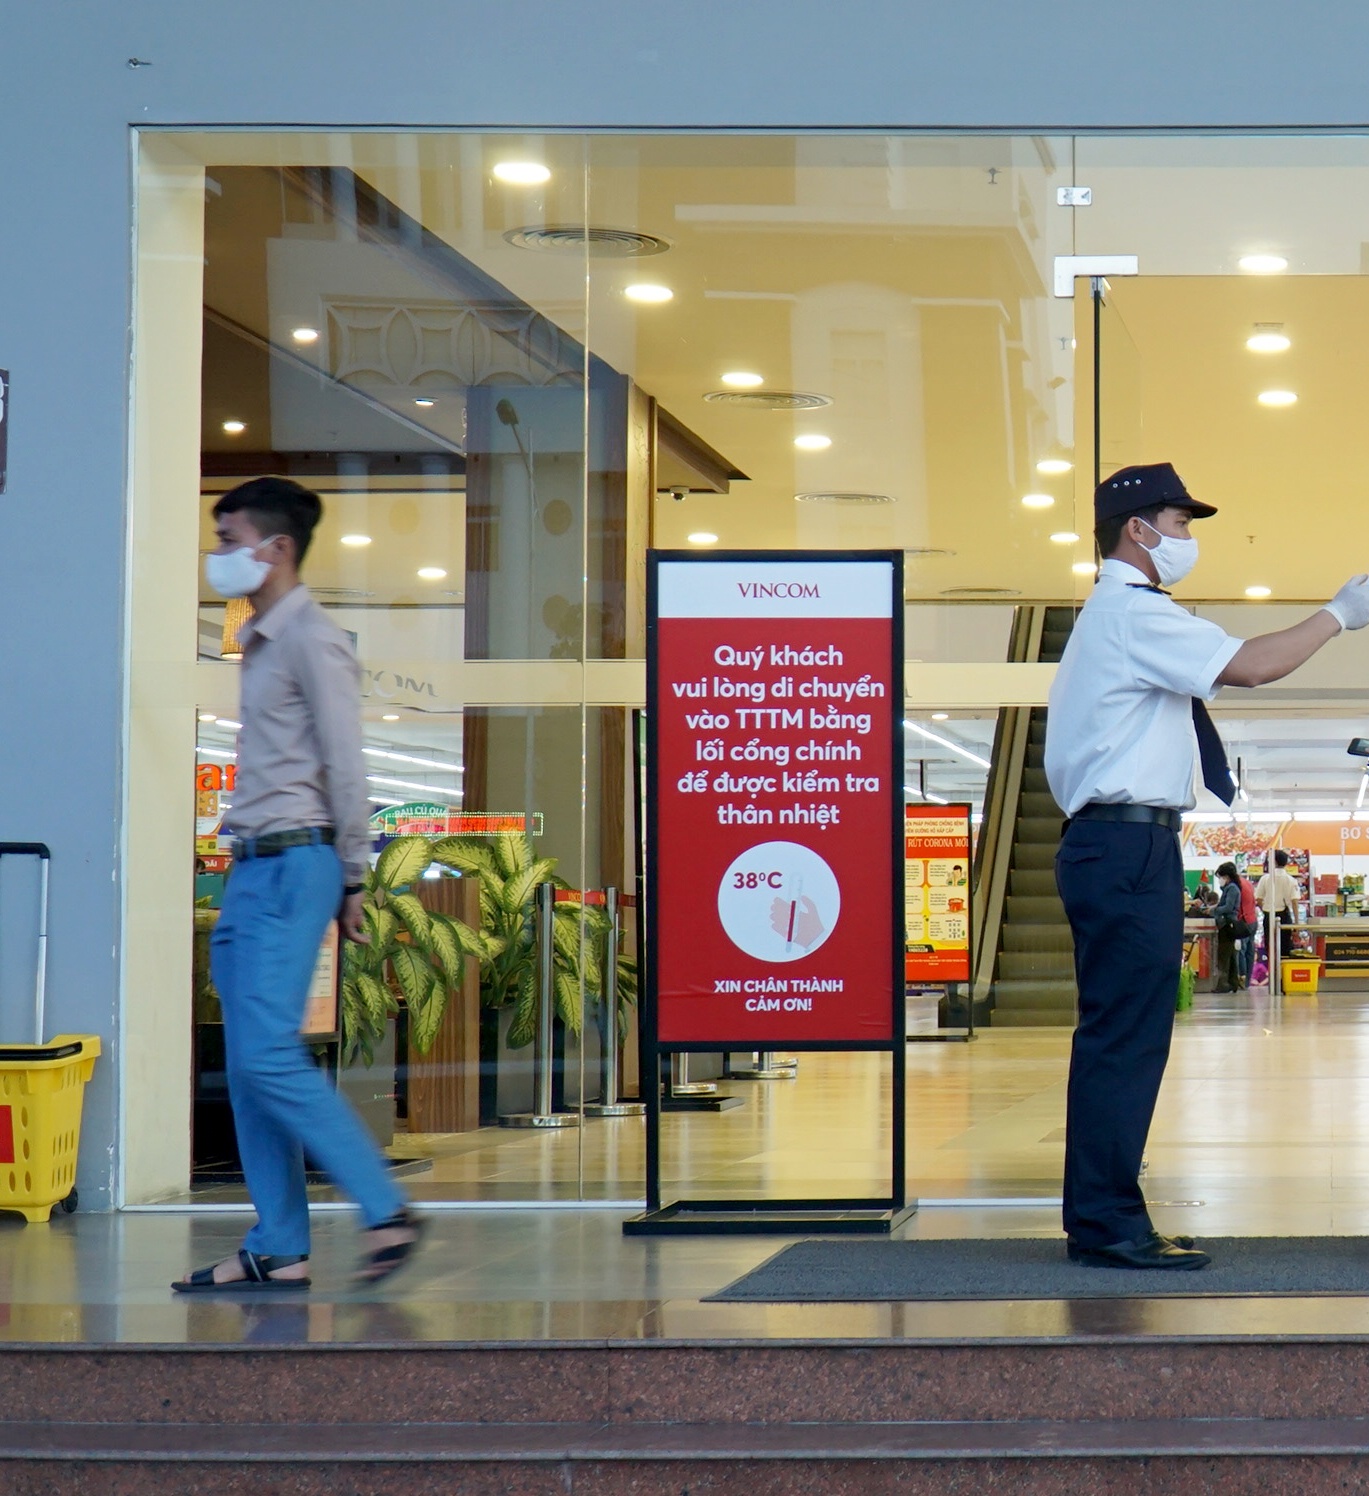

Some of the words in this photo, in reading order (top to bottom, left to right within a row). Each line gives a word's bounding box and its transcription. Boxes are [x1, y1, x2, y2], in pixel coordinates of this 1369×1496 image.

[738, 583, 819, 598] VINCOM
[714, 645, 764, 670] Quý
[770, 645, 843, 666] khách
[672, 677, 707, 698] vui
[714, 677, 765, 703] lòng
[771, 677, 793, 698] di
[799, 675, 885, 702] chuyển
[686, 709, 730, 729] vào
[735, 709, 803, 729] TTTM
[810, 705, 871, 734] bằng
[696, 738, 724, 761] lối
[730, 738, 790, 766] cổng
[795, 740, 861, 761] chính
[677, 770, 708, 793] để
[713, 772, 777, 798] được
[783, 770, 840, 792] kiểm
[845, 773, 879, 792] tra
[717, 804, 773, 824] thân
[779, 803, 840, 830] nhiệt
[908, 837, 923, 848] RÚT
[924, 838, 953, 848] CORONA
[714, 980, 741, 993] XIN
[744, 977, 788, 993] CHÂN
[790, 977, 843, 992] THÀNH
[745, 996, 780, 1012] CẢM
[783, 998, 812, 1011] ƠN!
